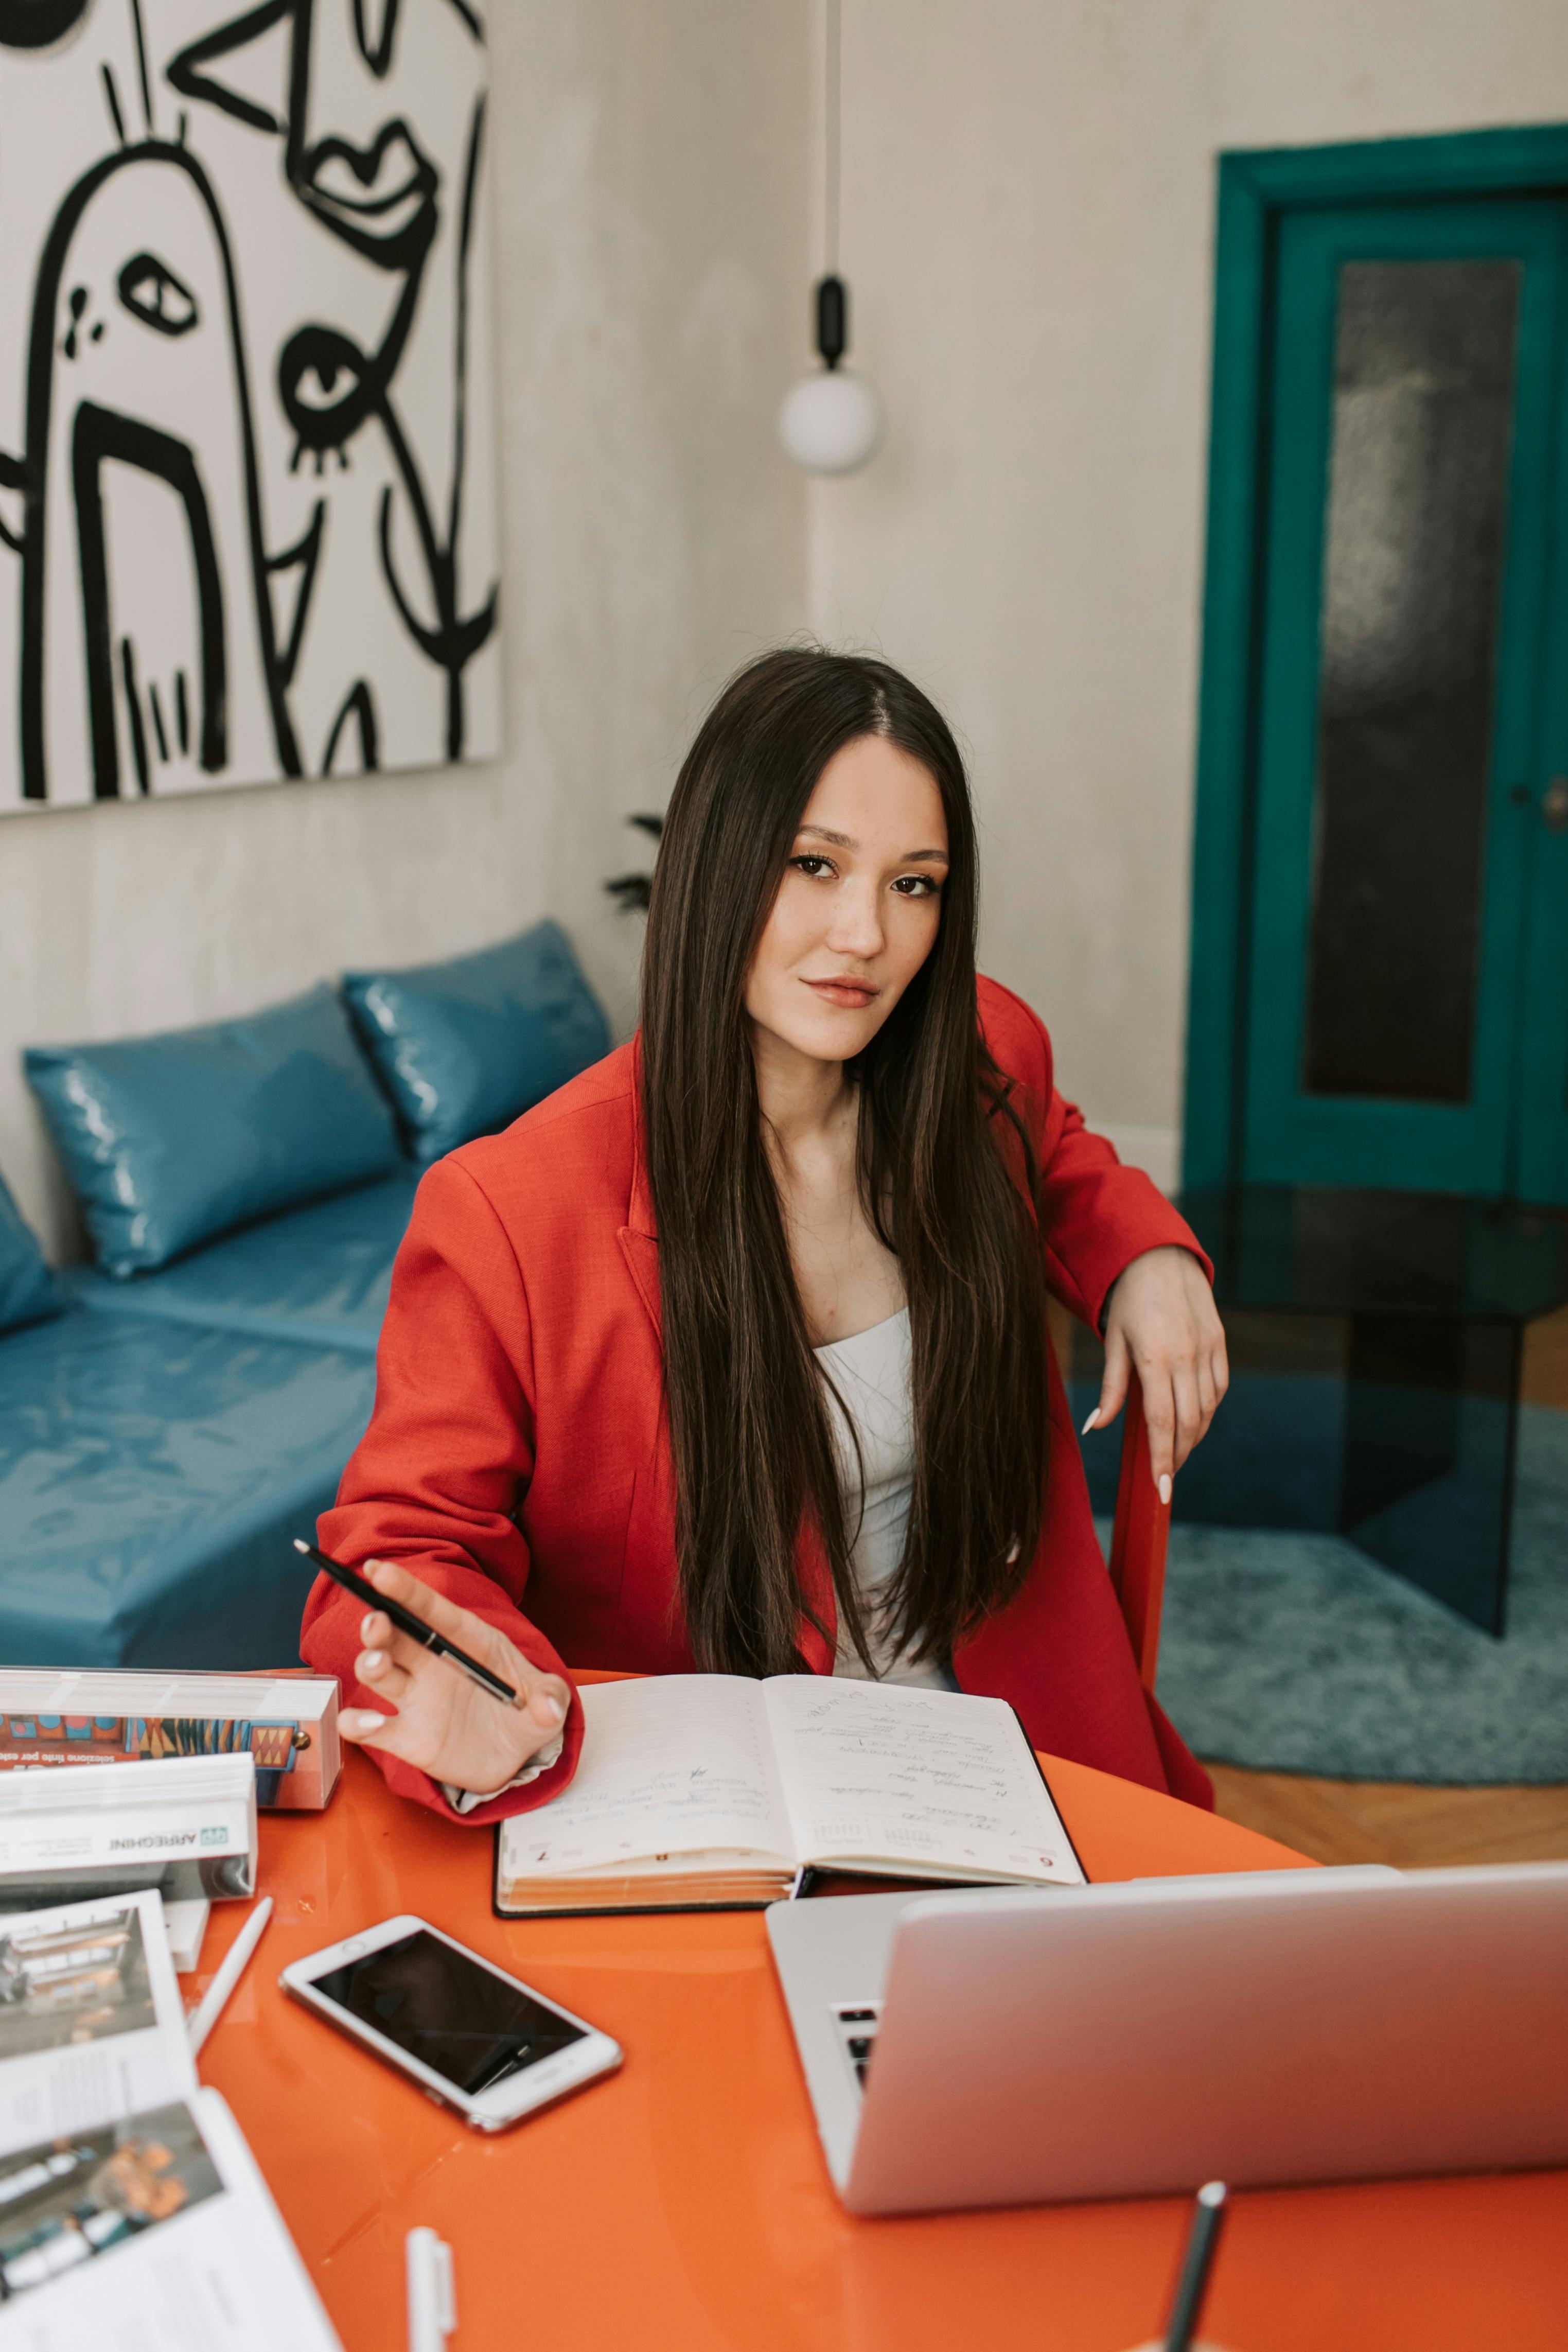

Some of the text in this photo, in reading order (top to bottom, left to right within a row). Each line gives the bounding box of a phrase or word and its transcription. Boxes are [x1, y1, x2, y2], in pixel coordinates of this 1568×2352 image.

[21, 1751, 39, 1761] per
[67, 1753, 115, 1764] selezione
[109, 1833, 197, 1851] ARREGHINI
